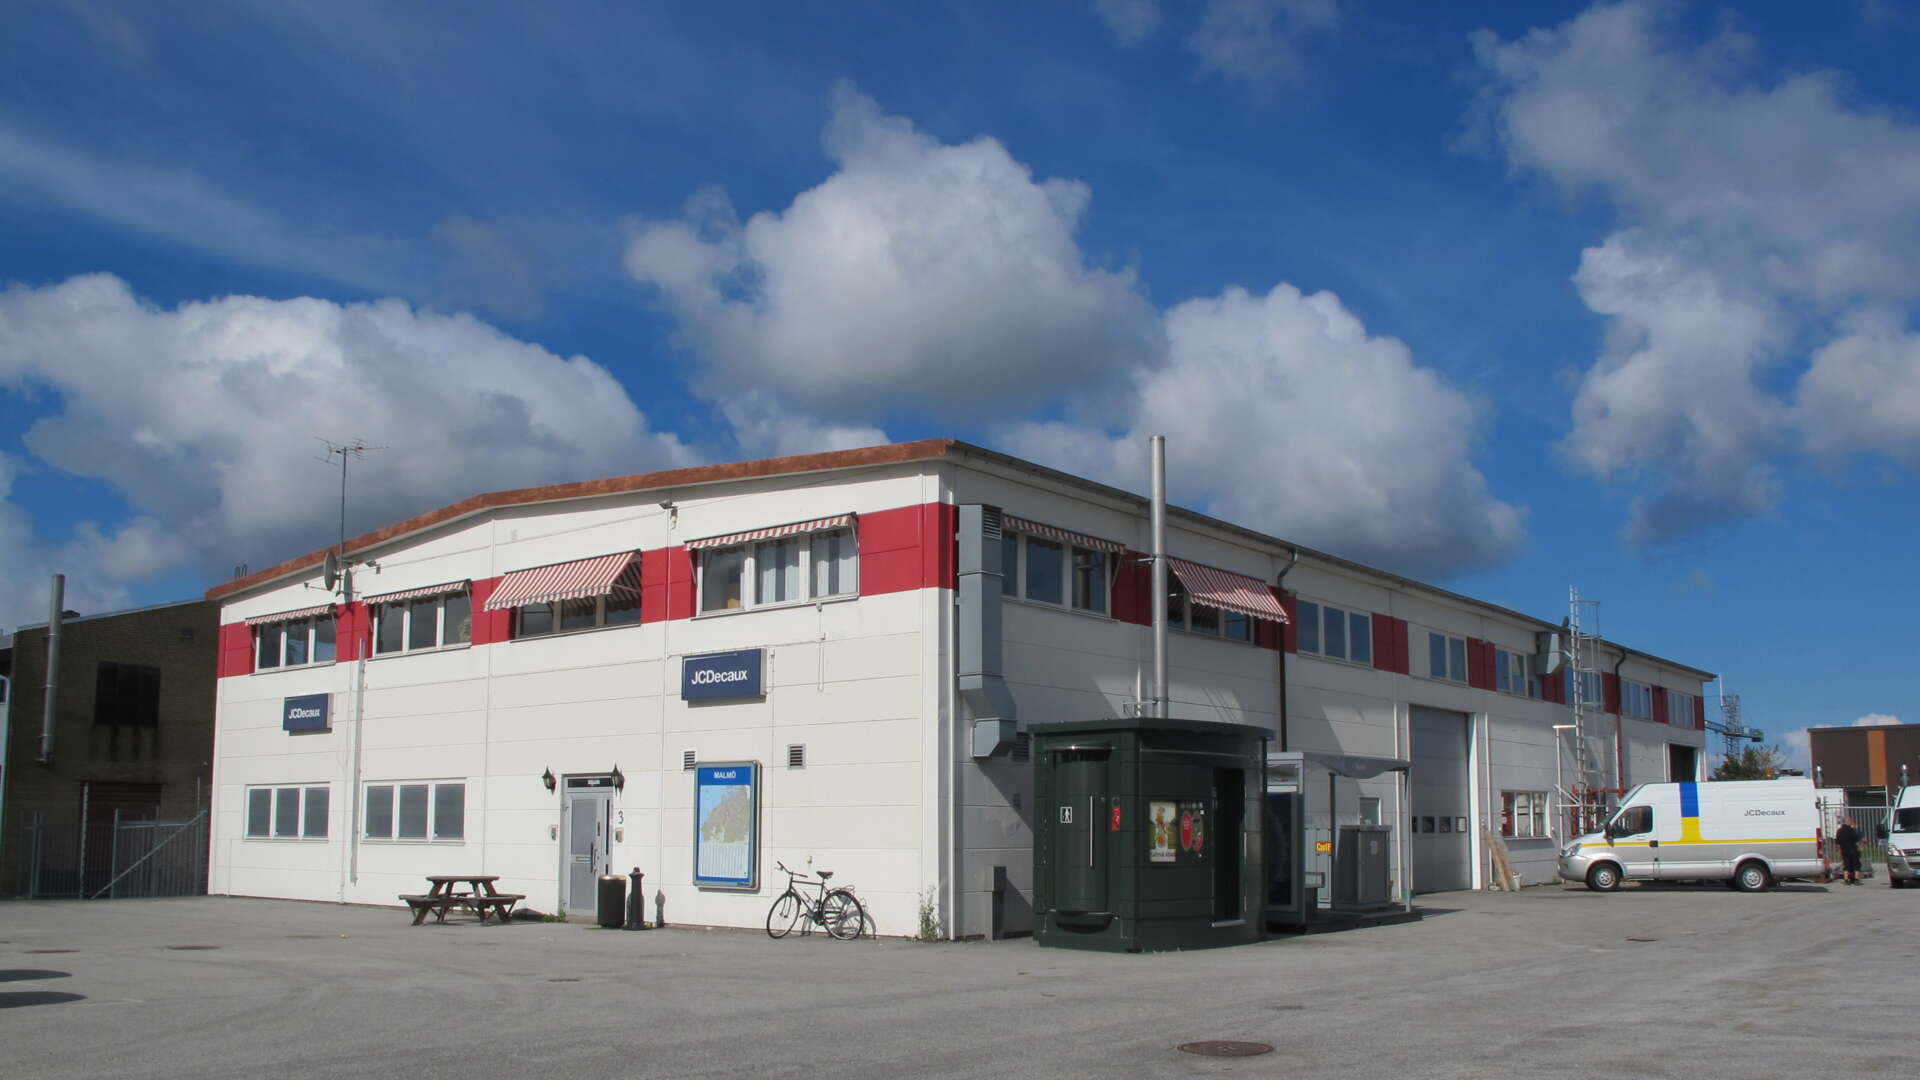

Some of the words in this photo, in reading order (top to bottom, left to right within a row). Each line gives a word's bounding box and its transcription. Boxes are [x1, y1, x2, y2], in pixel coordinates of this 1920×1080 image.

[690, 669, 748, 685] JCDecaux
[289, 708, 321, 719] JCDecaux
[713, 770, 737, 779] MALMÖ
[618, 810, 624, 824] 3
[1744, 808, 1786, 817] JCDecaux
